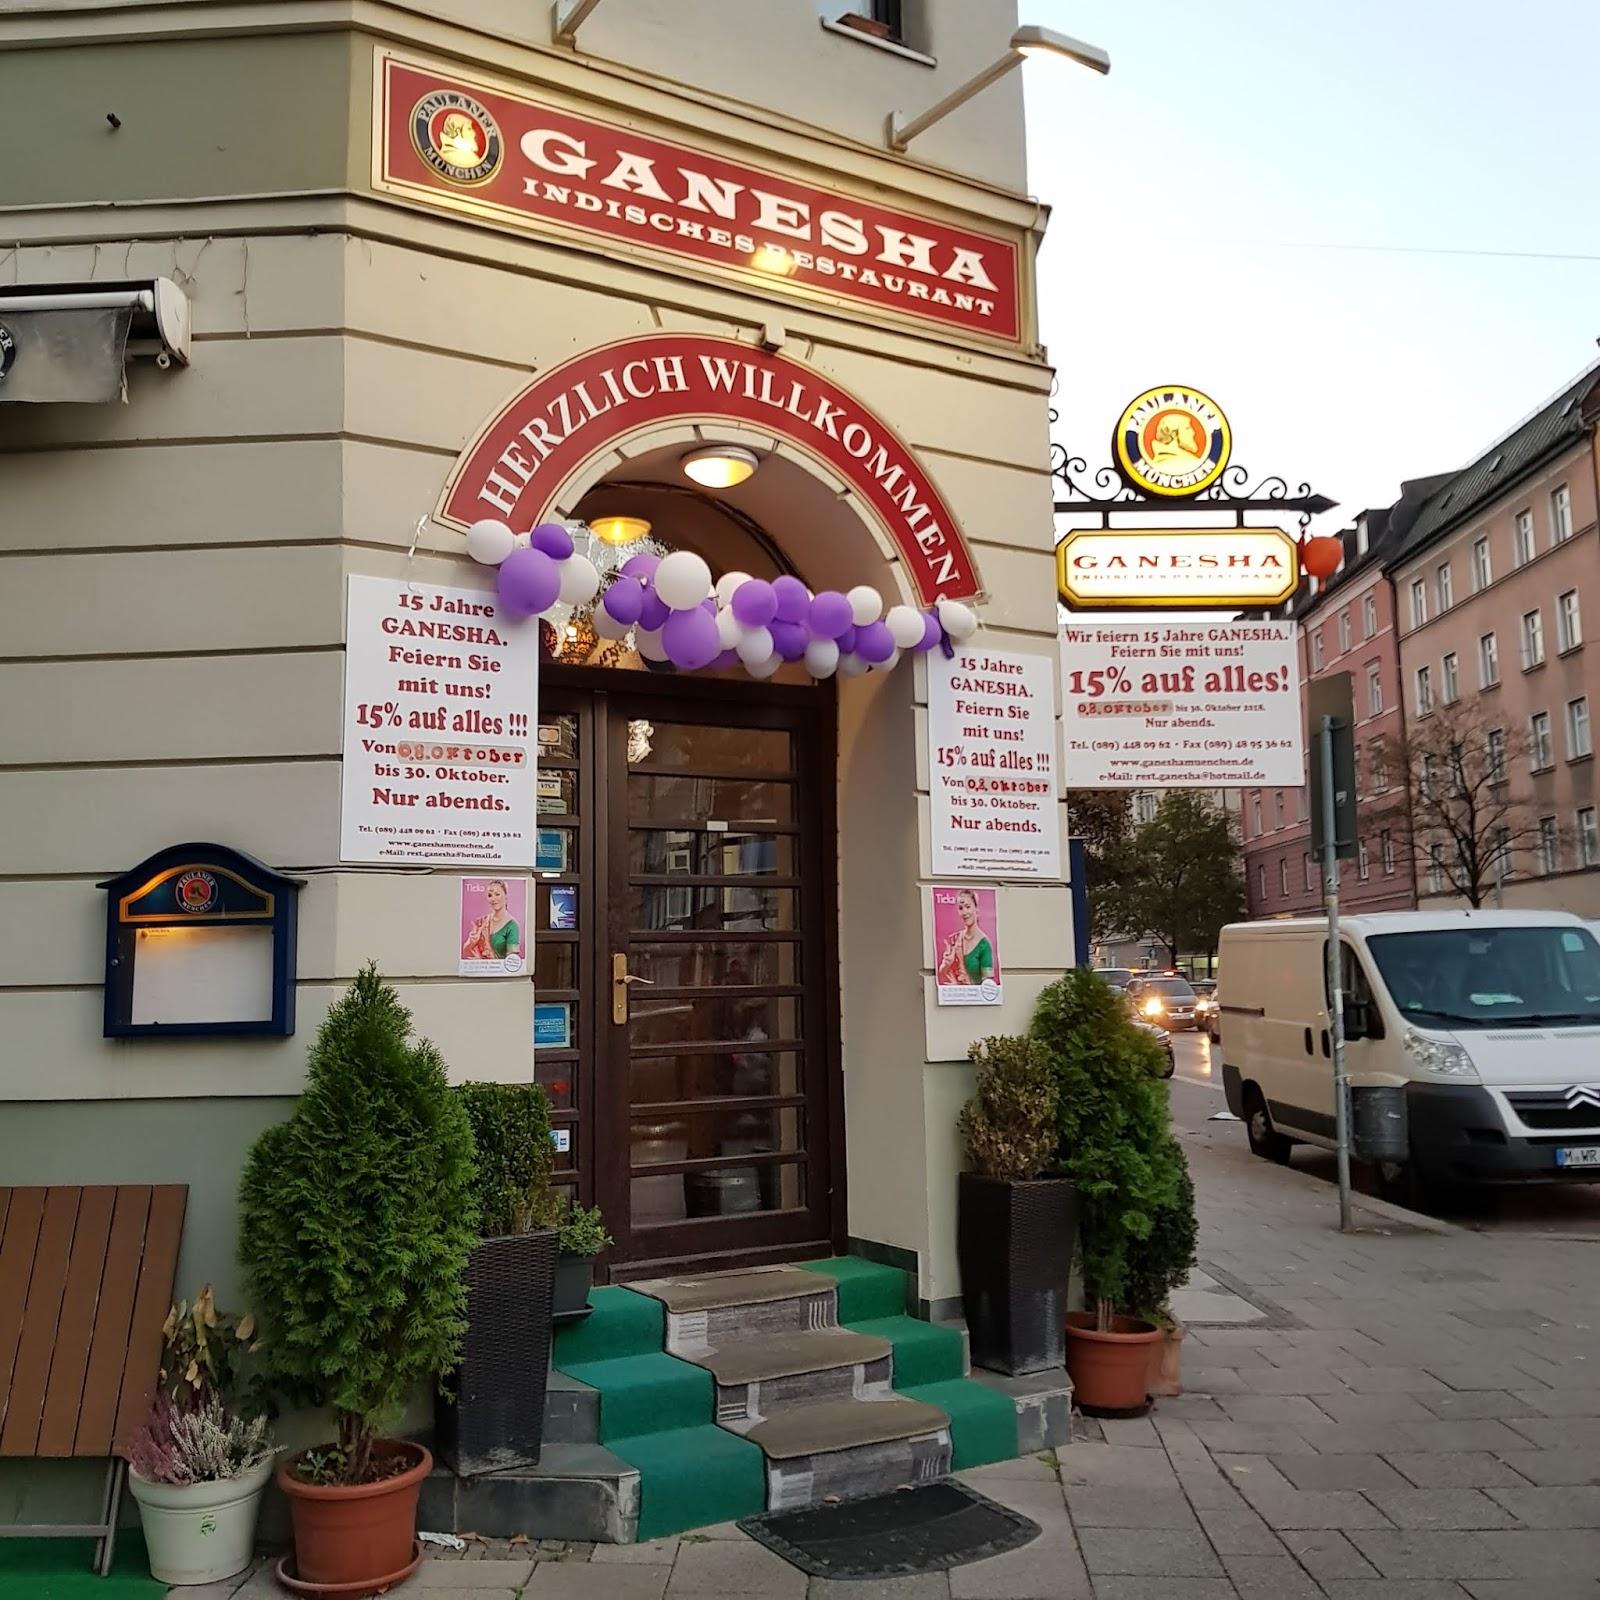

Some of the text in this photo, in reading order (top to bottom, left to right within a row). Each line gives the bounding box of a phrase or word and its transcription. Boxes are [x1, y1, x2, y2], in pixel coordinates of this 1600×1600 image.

[418, 94, 497, 138] PAULANER
[520, 127, 1000, 294] GANESHA
[477, 354, 961, 587] HERZLICH WILLKOMMEN
[1073, 555, 1284, 569] GANESHA
[399, 594, 495, 617] 15 Jahre
[381, 617, 508, 646] GANESHA.
[1066, 628, 1289, 644] Wir feiern 15 Jahre GANESHA.
[388, 645, 501, 672] Feiern Sie
[1110, 645, 1244, 658] Feiern Sie mit uns!
[960, 657, 1023, 675] 15 Jahre
[398, 677, 491, 699] mit uns!
[950, 677, 1034, 698] GANESHA.
[1069, 665, 1289, 697] 15% auf alles!
[956, 700, 1030, 720] Feiern Sie
[1204, 703, 1241, 712] Oktober
[356, 702, 402, 728] 15%
[409, 706, 447, 730] auf
[452, 709, 503, 735] alles
[1145, 717, 1215, 728] Nur abends.
[963, 726, 1024, 742] mit uns!
[361, 739, 397, 755] Von
[1070, 741, 1088, 749] Tel.
[1091, 741, 1120, 751] (089)
[1143, 742, 1156, 750] 09
[1159, 741, 1170, 749] 62
[1183, 740, 1201, 748] Fax
[1204, 740, 1232, 750] (089)
[1250, 741, 1262, 750] 95
[1266, 740, 1278, 749] 36
[937, 745, 967, 767] 15%
[971, 749, 995, 768] auf
[1000, 750, 1033, 771] alles
[1110, 758, 1254, 768] www.ganeshamuenchen.de
[375, 763, 510, 784] bis 30. Oktober.
[942, 776, 964, 788] Von
[372, 788, 511, 811] Nur abends.
[951, 795, 1040, 810] bis 30. Oktober.
[358, 825, 373, 833] Tel.
[950, 815, 1042, 833] Nur abends.
[179, 872, 216, 889] PAULANER
